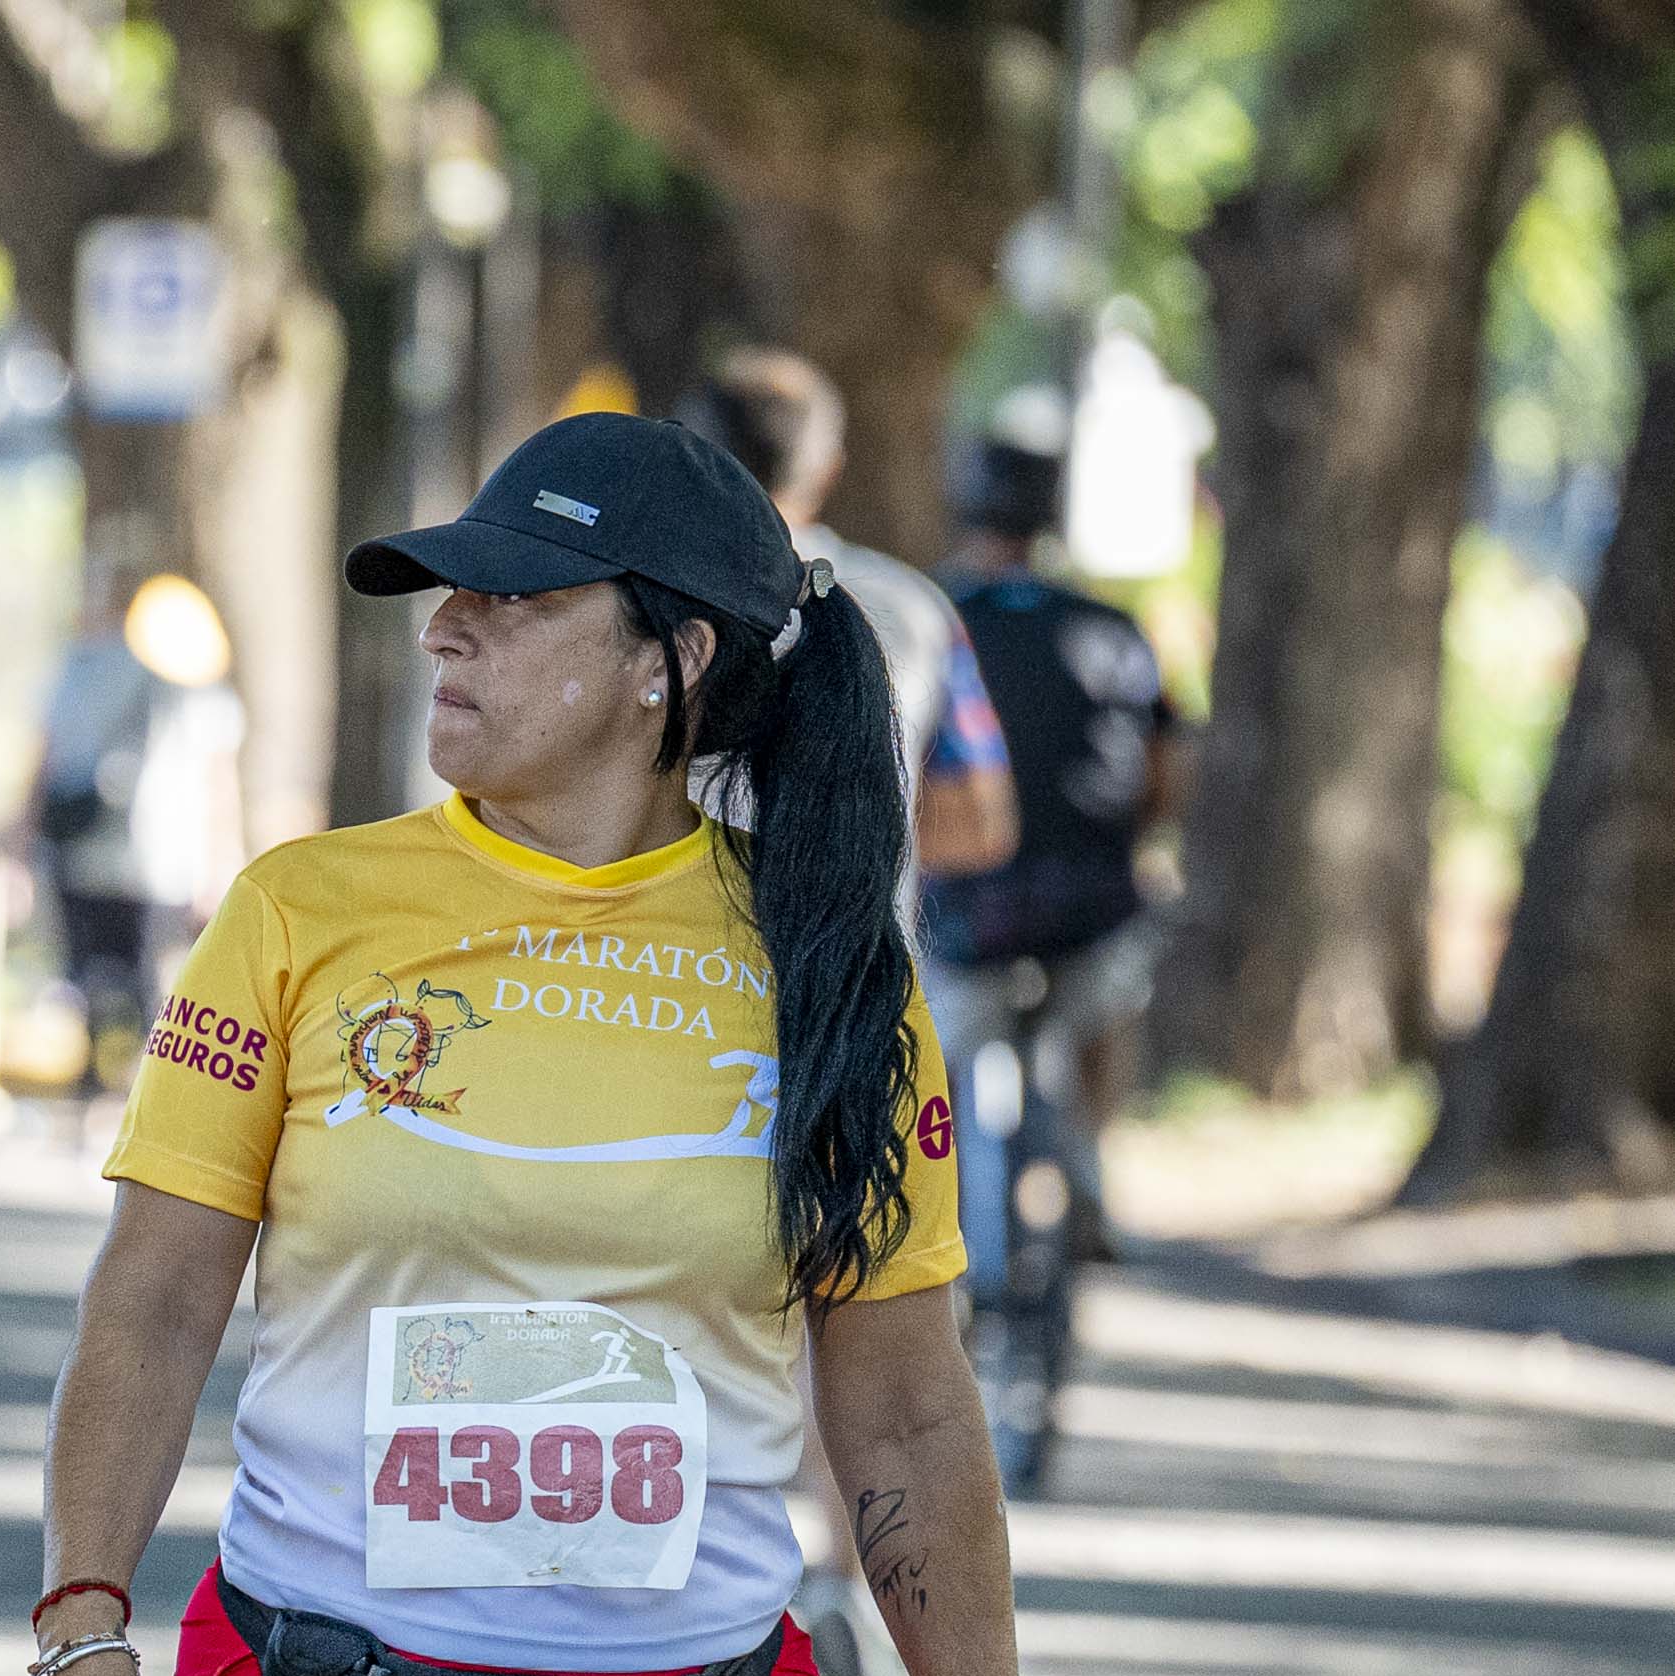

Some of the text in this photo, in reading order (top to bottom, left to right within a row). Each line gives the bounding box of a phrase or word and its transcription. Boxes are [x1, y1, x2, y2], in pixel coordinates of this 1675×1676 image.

[508, 924, 772, 1000] MARATÓN
[156, 994, 268, 1063] ANCOR
[490, 976, 718, 1041] DORADA
[145, 1028, 260, 1092] EGUROS
[506, 1328, 570, 1341] DORADA
[373, 1424, 684, 1525] 4398
